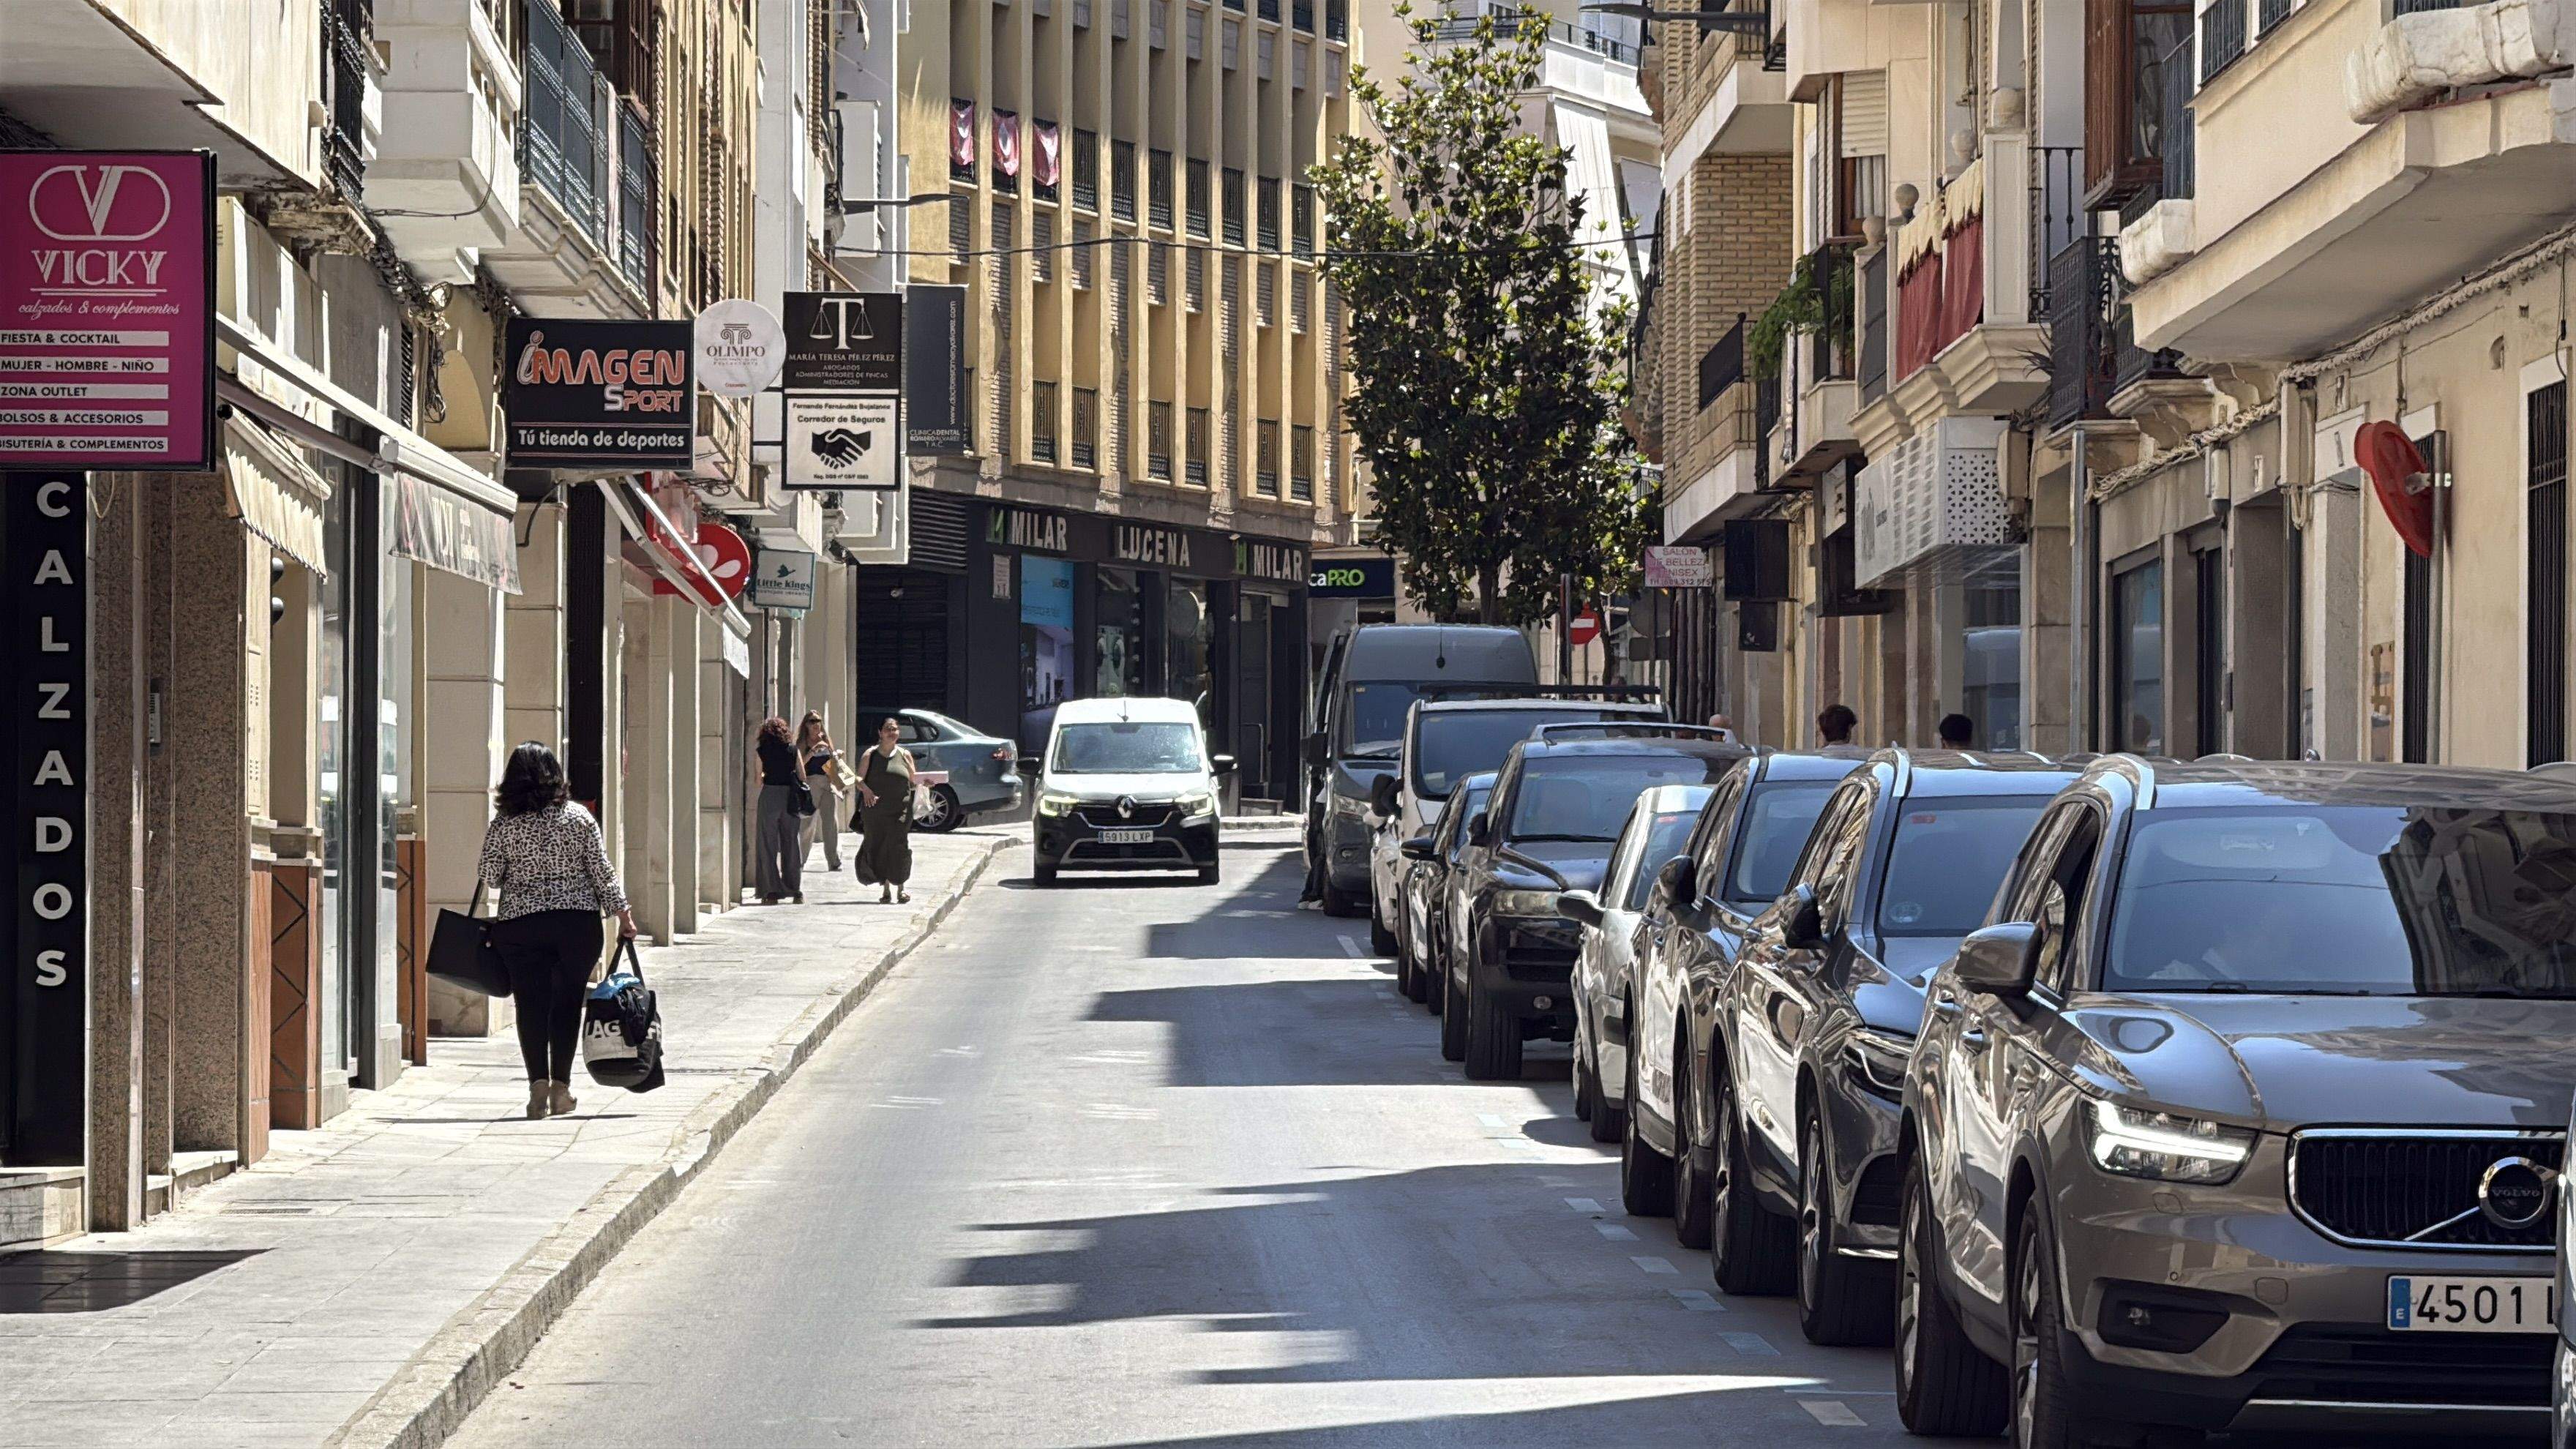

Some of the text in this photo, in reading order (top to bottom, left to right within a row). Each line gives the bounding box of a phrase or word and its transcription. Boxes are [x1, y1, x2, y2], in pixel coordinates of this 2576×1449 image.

[31, 250, 167, 285] VICKY
[18, 299, 179, 321] calzados & complementos
[1, 333, 120, 344] FIESTA & COCKTAIL
[706, 345, 765, 357] OLIMPO
[788, 353, 817, 362] MARÍA
[0, 360, 42, 370] MUJER
[55, 361, 108, 371] HOMBRE
[121, 359, 154, 371] NIÑO
[1, 386, 87, 397] ZONA OUTLET
[604, 383, 684, 412] SPORT
[50, 414, 59, 423] &
[64, 414, 143, 424] ACCESORIOS
[797, 415, 835, 423] Corredor
[850, 415, 886, 424] Seguros
[0, 438, 164, 449] ISUTERÍA & COMPLEMENTOS
[518, 430, 684, 451] Tú tienda de deportes
[1012, 511, 1066, 550] MILAR
[1119, 525, 1190, 566] LUCENA
[1254, 544, 1303, 581] MILAR
[33, 482, 73, 987] CALZADOS
[2492, 1186, 2541, 1197] VOLVO
[2417, 1284, 2522, 1324] 4501
